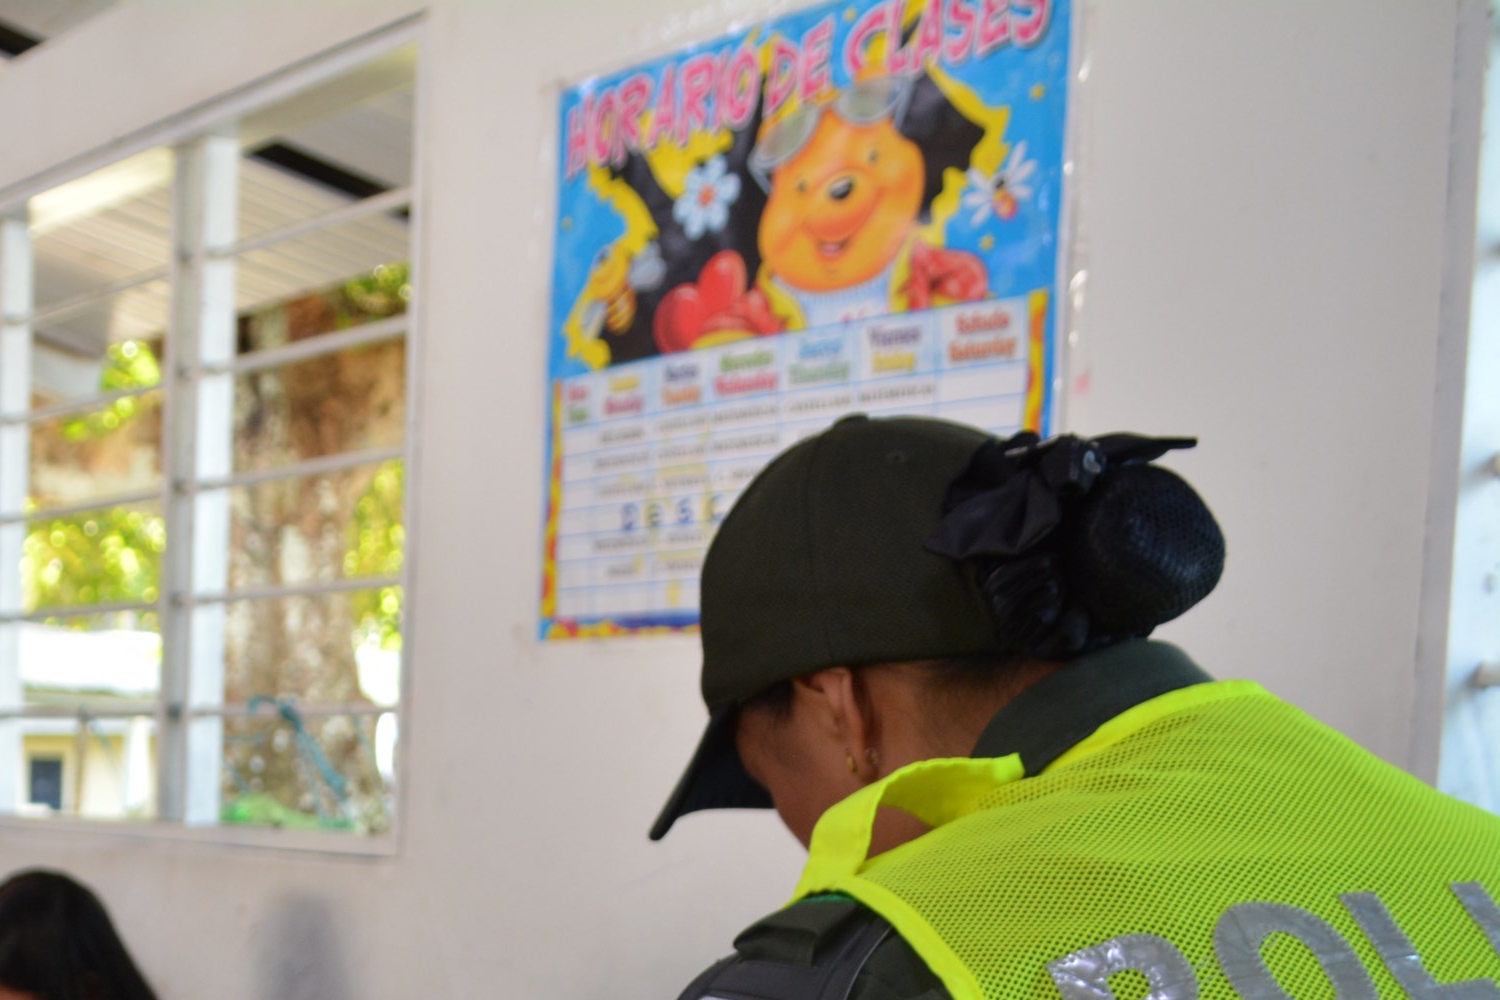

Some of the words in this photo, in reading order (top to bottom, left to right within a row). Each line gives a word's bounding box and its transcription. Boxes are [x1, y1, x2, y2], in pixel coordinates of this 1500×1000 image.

[564, 42, 765, 181] HORARIO
[762, 14, 838, 114] DE
[842, 0, 1054, 80] CLASES
